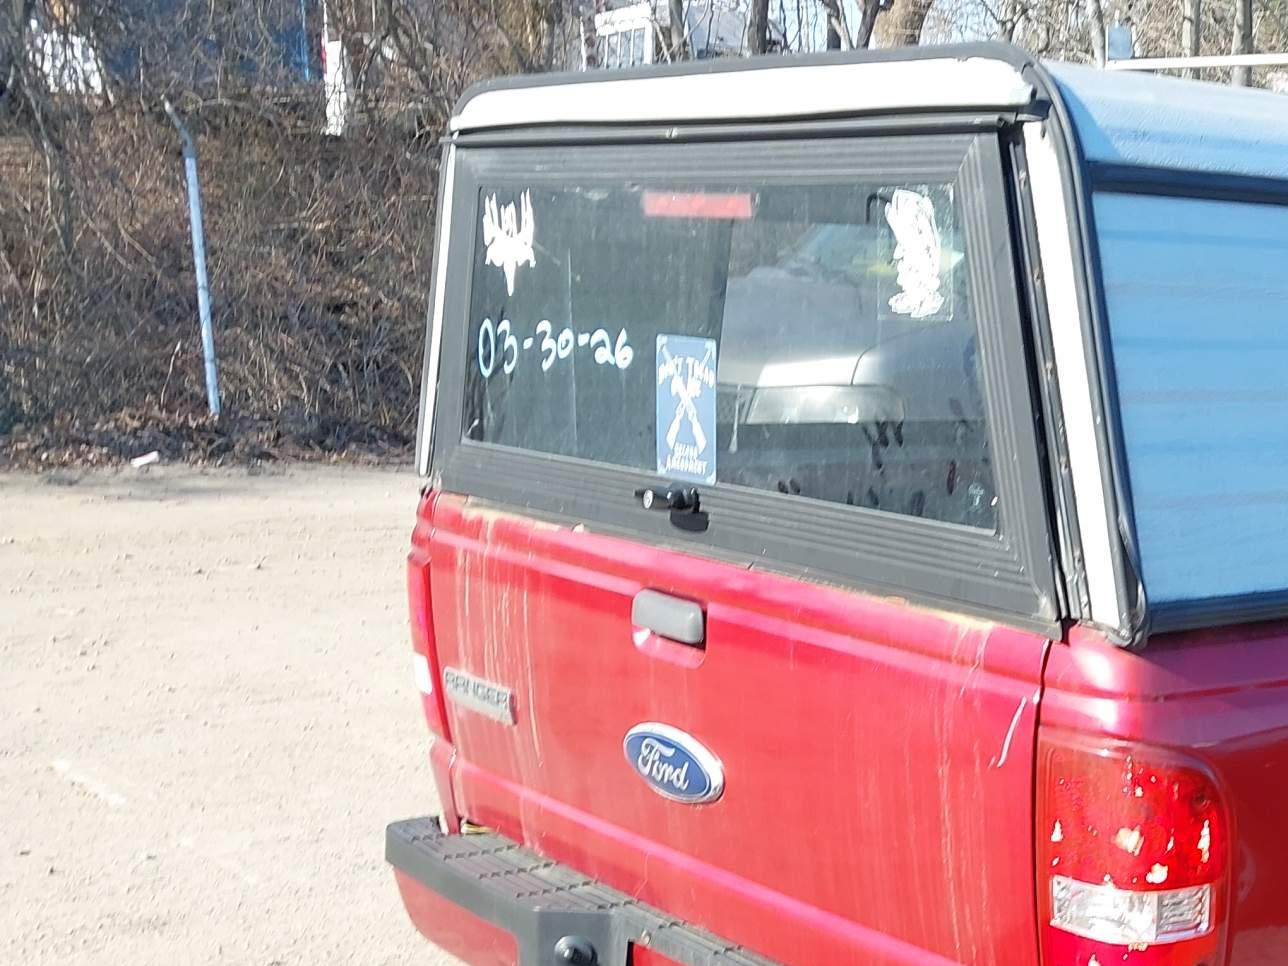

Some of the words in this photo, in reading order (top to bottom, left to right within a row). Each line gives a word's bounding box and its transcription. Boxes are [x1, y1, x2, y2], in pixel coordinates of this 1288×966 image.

[478, 317, 634, 378] 03-30-26
[445, 671, 509, 710] RANGER
[637, 738, 690, 791] Ford
